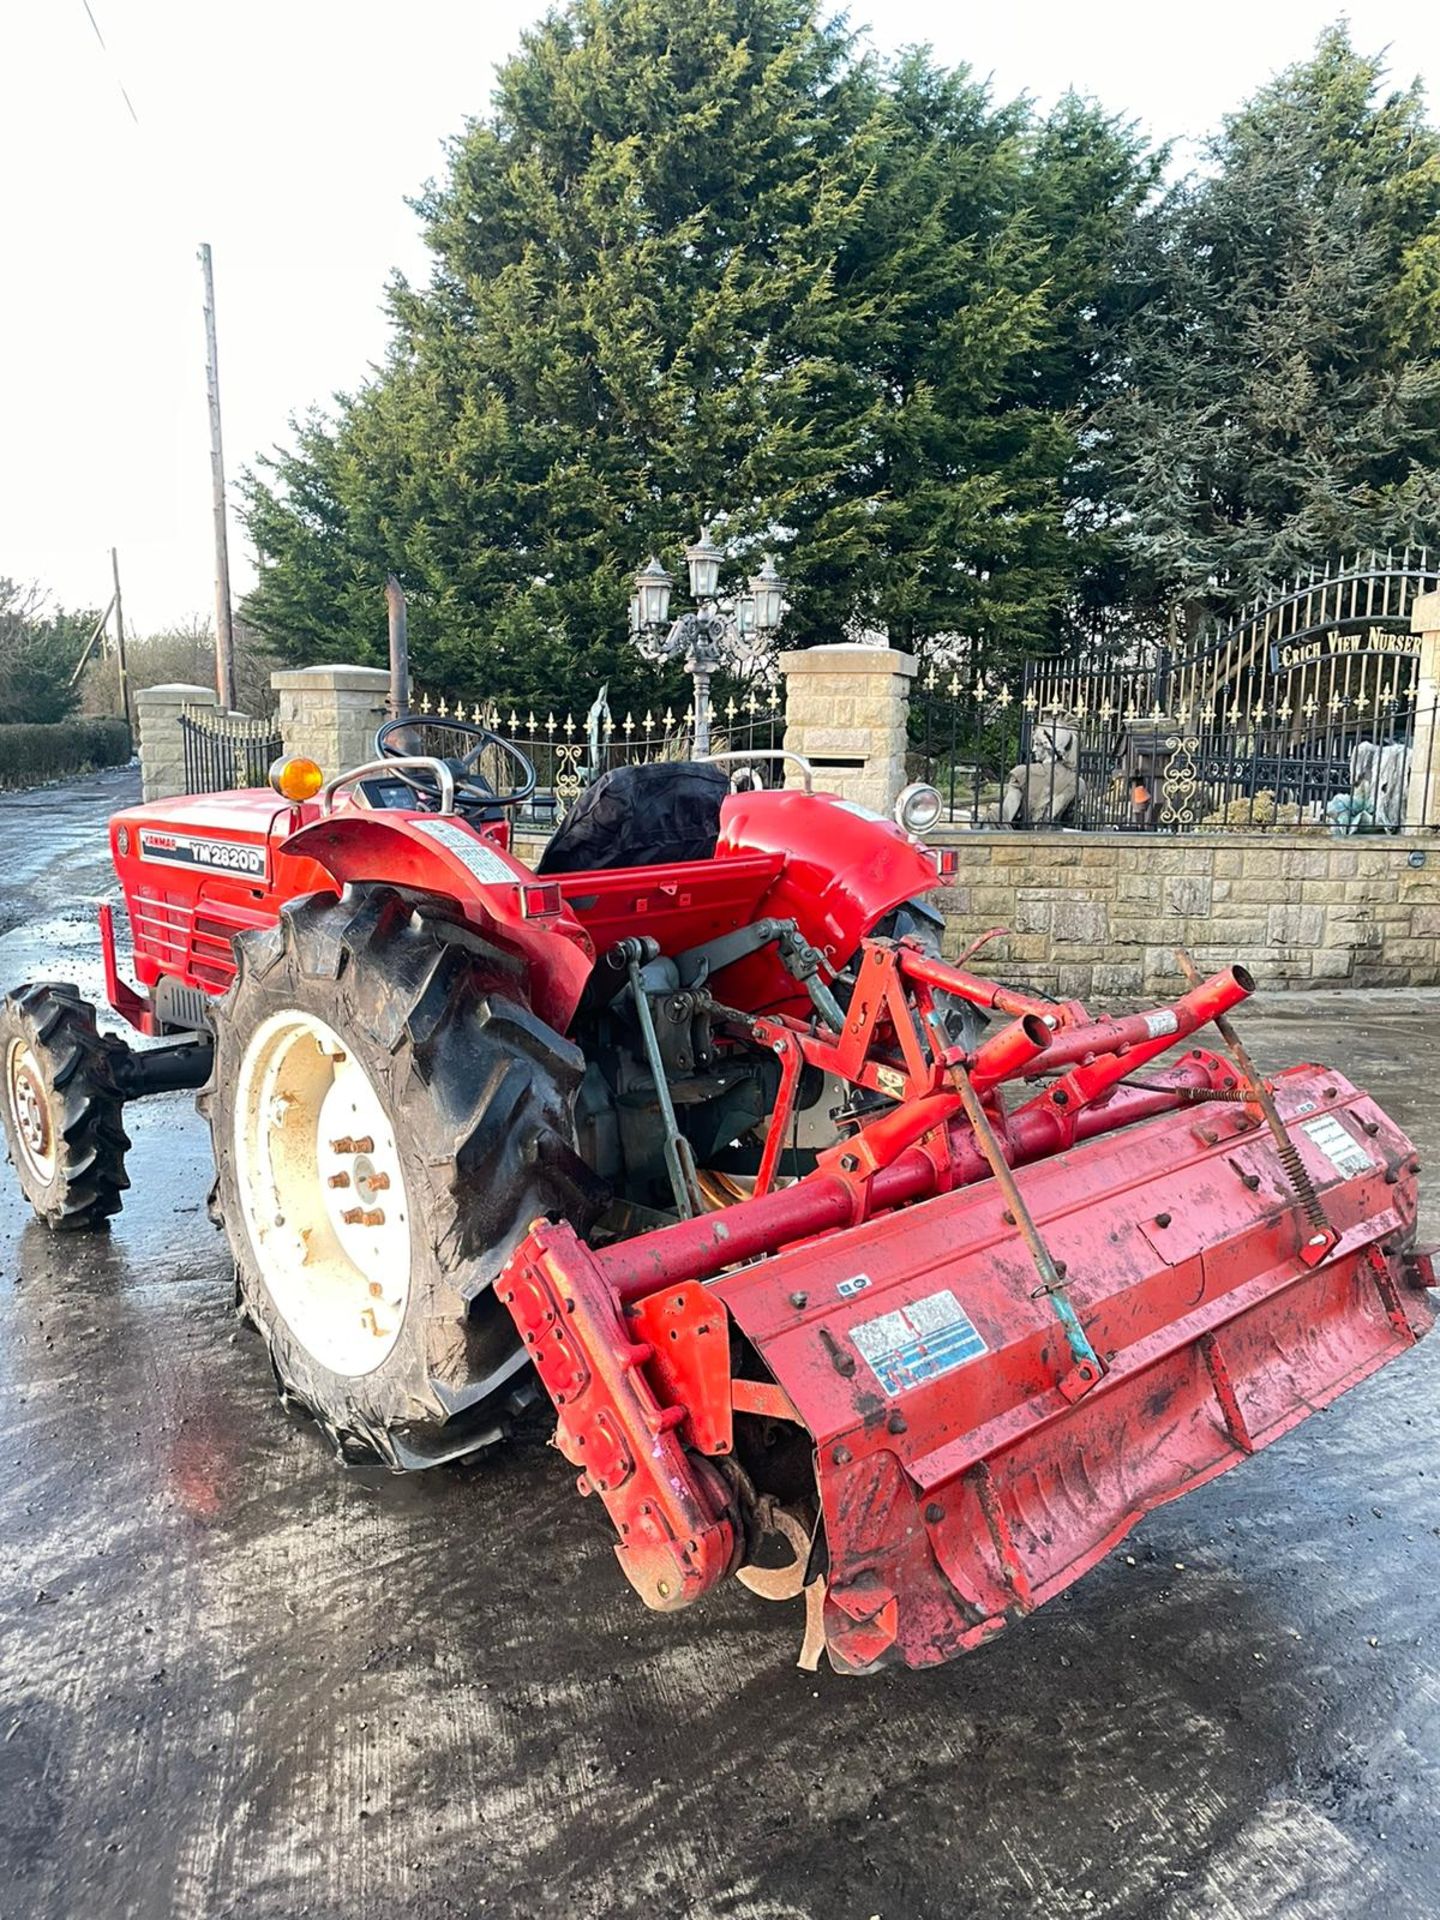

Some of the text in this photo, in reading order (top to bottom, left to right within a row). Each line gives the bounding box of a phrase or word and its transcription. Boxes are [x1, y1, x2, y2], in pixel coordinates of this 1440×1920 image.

[1282, 626, 1422, 667] CRICH VIEW NURSER
[144, 835, 259, 870] YANMAR YM2820D
